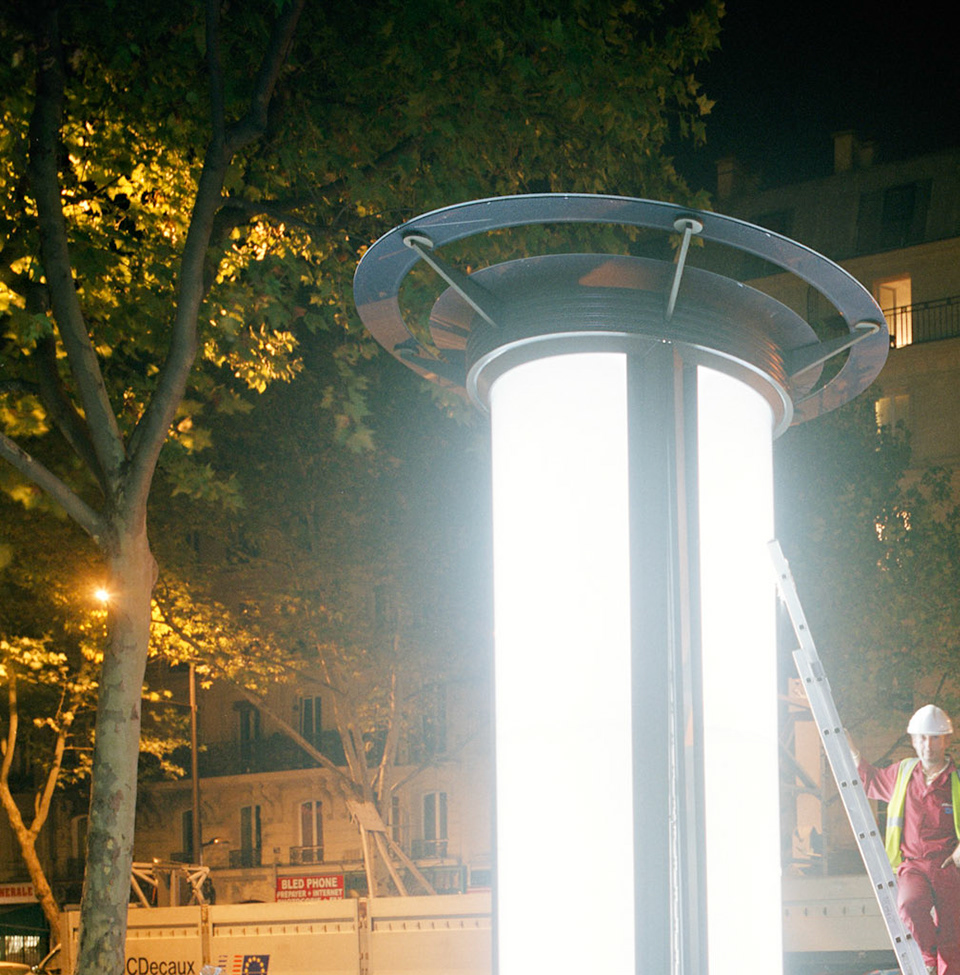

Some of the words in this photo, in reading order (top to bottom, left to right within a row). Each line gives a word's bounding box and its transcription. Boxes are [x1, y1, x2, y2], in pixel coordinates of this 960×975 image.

[281, 879, 304, 889] BLED
[306, 877, 338, 888] PHONE
[312, 889, 342, 897] INTERNET
[126, 957, 195, 975] CDecaux
